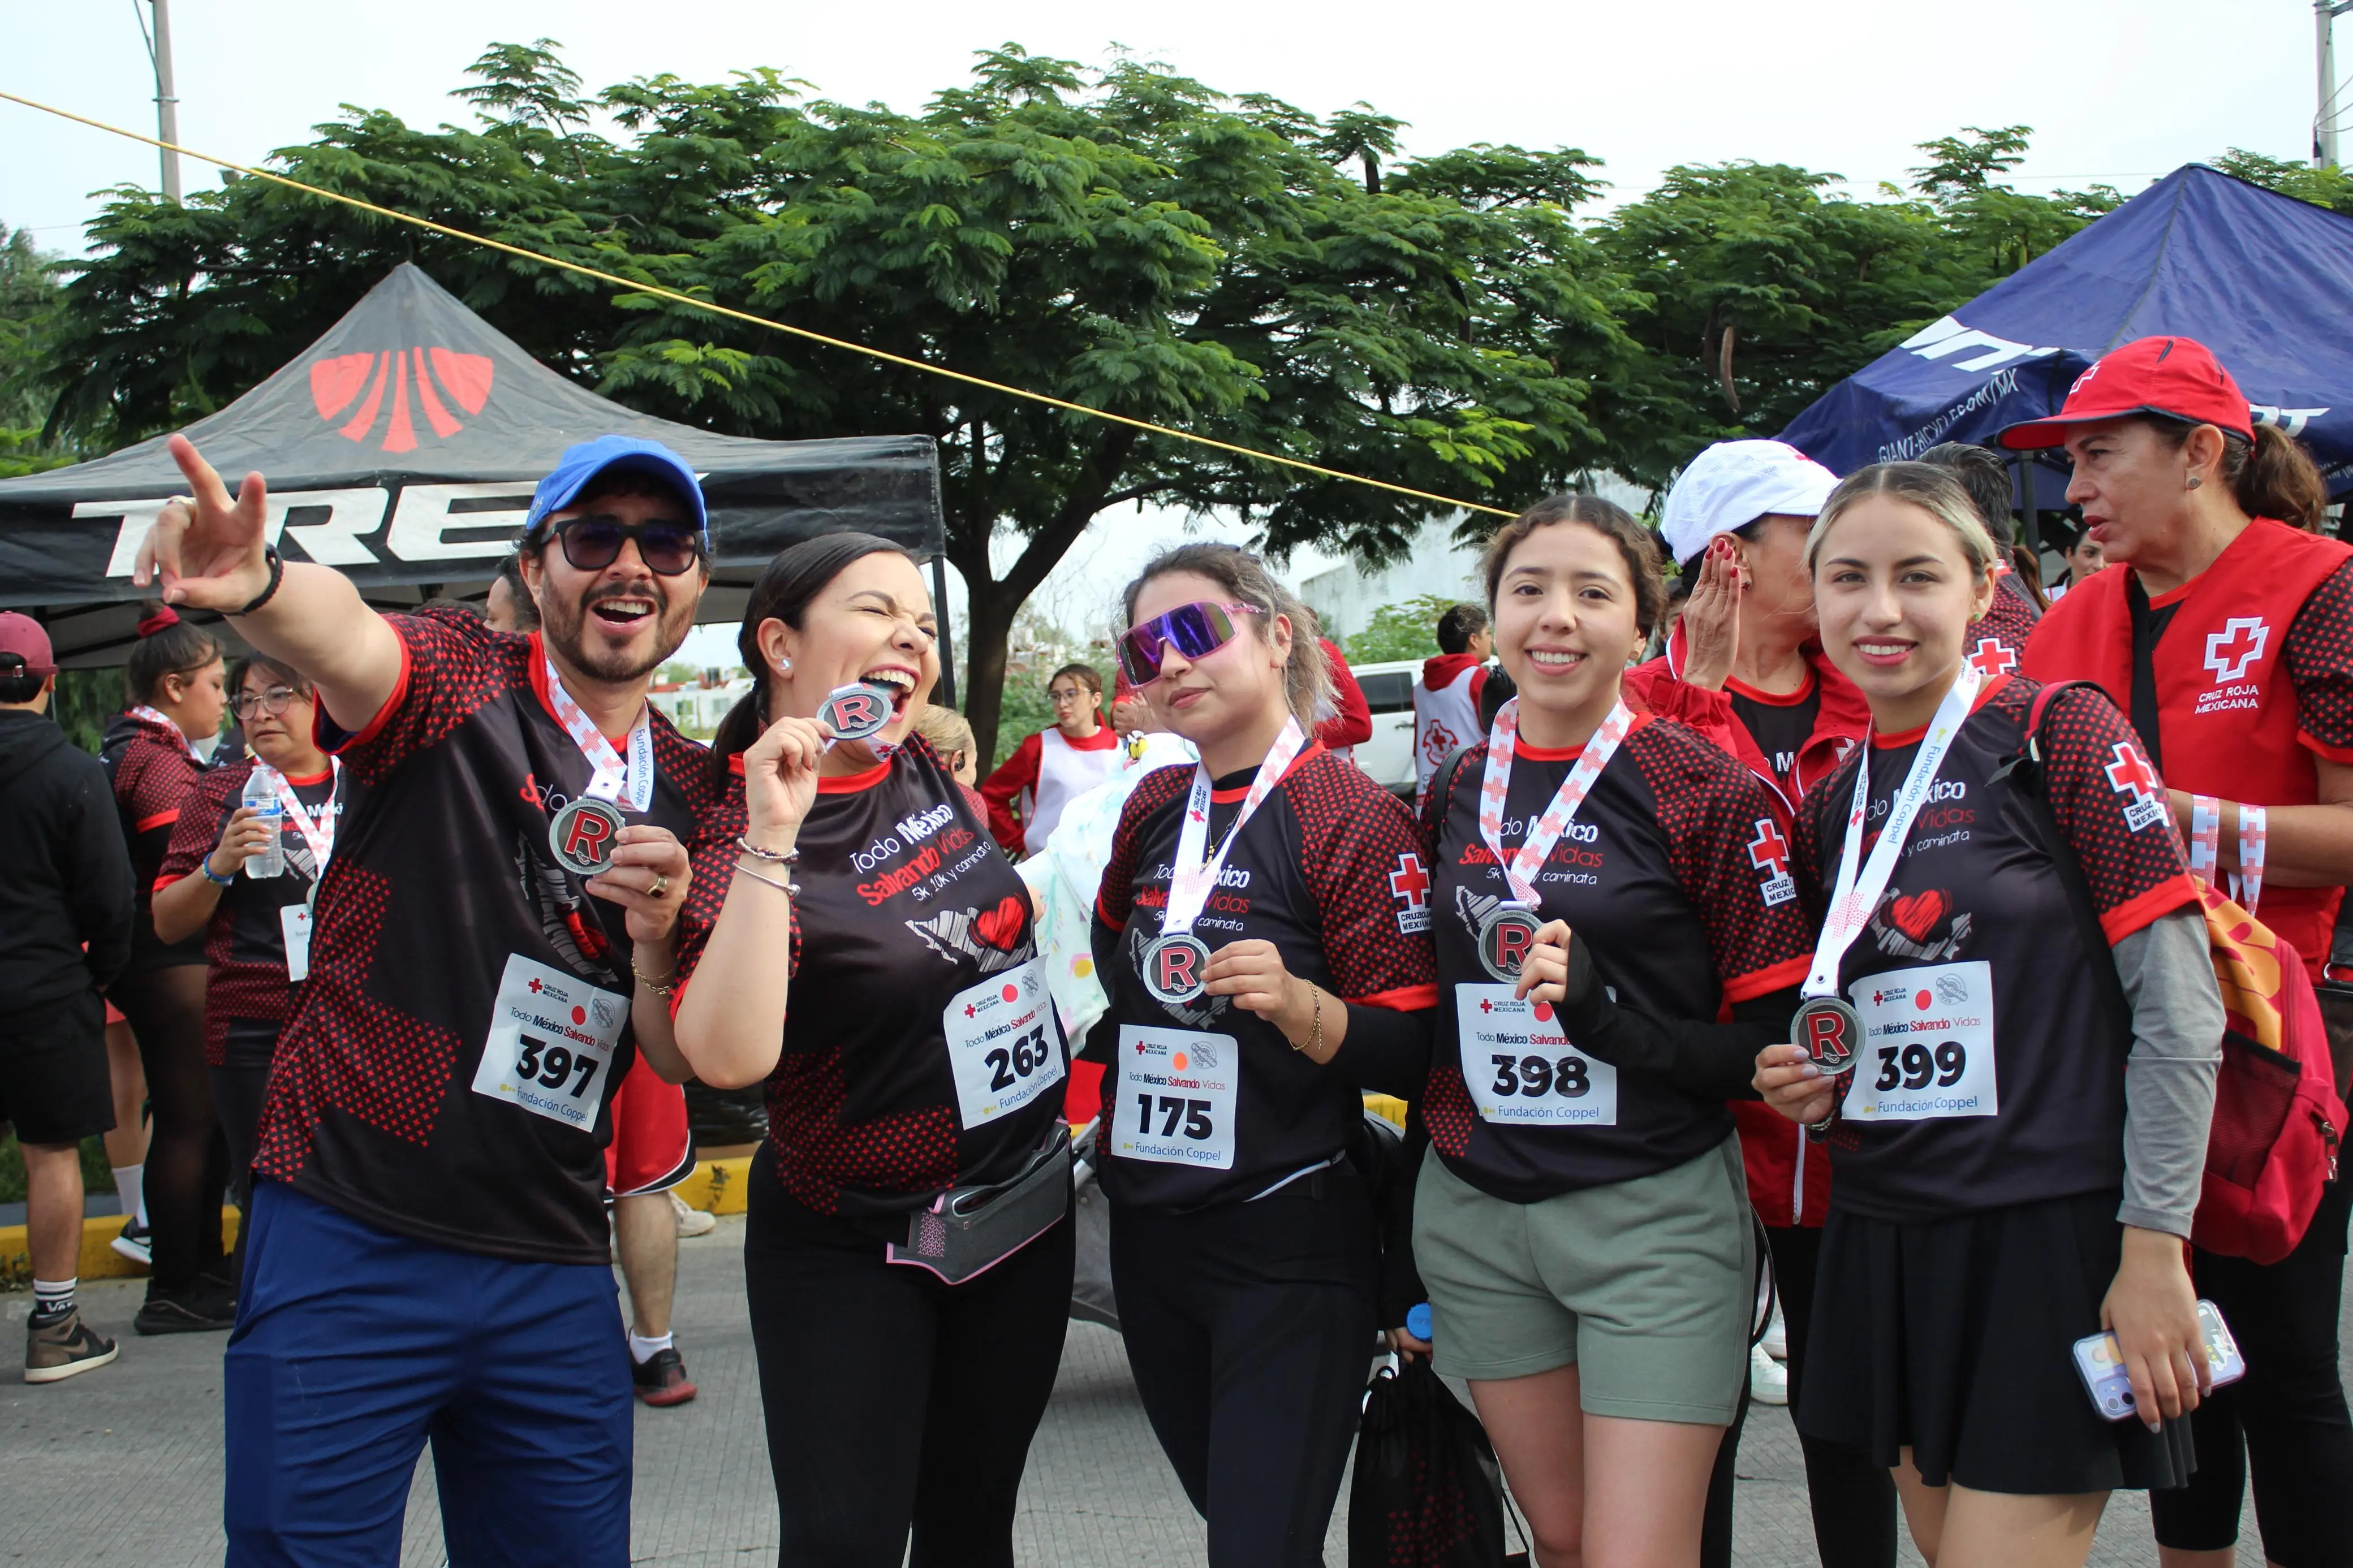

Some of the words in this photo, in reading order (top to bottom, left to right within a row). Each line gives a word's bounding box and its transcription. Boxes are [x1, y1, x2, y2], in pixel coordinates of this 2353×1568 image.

[72, 473, 709, 577] TRE
[2195, 698, 2259, 714] MEXICANA
[2199, 689, 2223, 702] CRUZ
[2226, 685, 2259, 697] ROJA
[832, 695, 879, 730] R
[636, 729, 649, 778] Fundación
[1906, 745, 1941, 801] Fundación
[635, 780, 649, 805] Coppel
[1866, 799, 1887, 821] do
[2129, 800, 2153, 817] CRUZ
[564, 809, 612, 863] R
[1499, 817, 1523, 837] do
[1887, 804, 1912, 844] Coppel
[850, 837, 900, 874] Todo
[895, 805, 954, 845] México
[1917, 830, 1970, 852] caminata
[856, 846, 941, 906] Salvando
[935, 828, 974, 855] Vidas
[930, 873, 950, 892] 10k
[946, 869, 958, 881] y
[955, 841, 992, 872] caminata
[1542, 870, 1597, 885] caminata
[1766, 879, 1789, 892] CRUZ
[1769, 887, 1795, 902] MEXIC
[1197, 917, 1244, 931] caminata
[1401, 912, 1421, 921] CRUZ
[1497, 922, 1533, 967] R
[1160, 946, 1197, 990] R
[542, 990, 567, 1003] MEXICANA
[544, 984, 557, 992] CRUZ
[557, 988, 568, 998] ROJA
[975, 999, 986, 1008] CRUZ
[986, 994, 998, 1003] ROJA
[977, 1000, 999, 1012] MEXICANA
[511, 1007, 532, 1022] Todo
[532, 1015, 563, 1035] México
[564, 1026, 596, 1046] Salvando
[597, 1039, 610, 1052] Vidas
[964, 1034, 984, 1048] Todo
[985, 1024, 1011, 1042] México
[1011, 1009, 1036, 1030] Salvando
[1035, 1000, 1047, 1013] Vidas
[1807, 1010, 1851, 1060] R
[1868, 1027, 1882, 1036] Todo
[1883, 1022, 1908, 1035] México
[1910, 1018, 1950, 1033] Salvando
[1953, 1017, 1981, 1026] Vidas
[1476, 1032, 1495, 1042] Todo
[1496, 1032, 1528, 1044] México
[515, 1034, 600, 1099] 397
[984, 1023, 1049, 1092] 263
[1875, 1041, 1966, 1091] 399
[999, 1081, 1038, 1109] Fundación
[1037, 1065, 1057, 1086] Coppel
[1129, 1072, 1143, 1082] Todo
[1143, 1073, 1167, 1086] México
[1167, 1076, 1200, 1089] Salvando
[1202, 1080, 1226, 1090] Vidas
[1492, 1054, 1590, 1098] 398
[518, 1086, 559, 1112] Fundación
[561, 1104, 588, 1122] Coppel
[1498, 1105, 1553, 1118] Fundación
[1557, 1107, 1599, 1120] Coppel
[1878, 1100, 1933, 1113] Fundación
[1934, 1096, 1977, 1111] Coppel
[1138, 1094, 1213, 1141] 175
[1135, 1142, 1184, 1156] Fundación
[1186, 1147, 1221, 1161] Coppel
